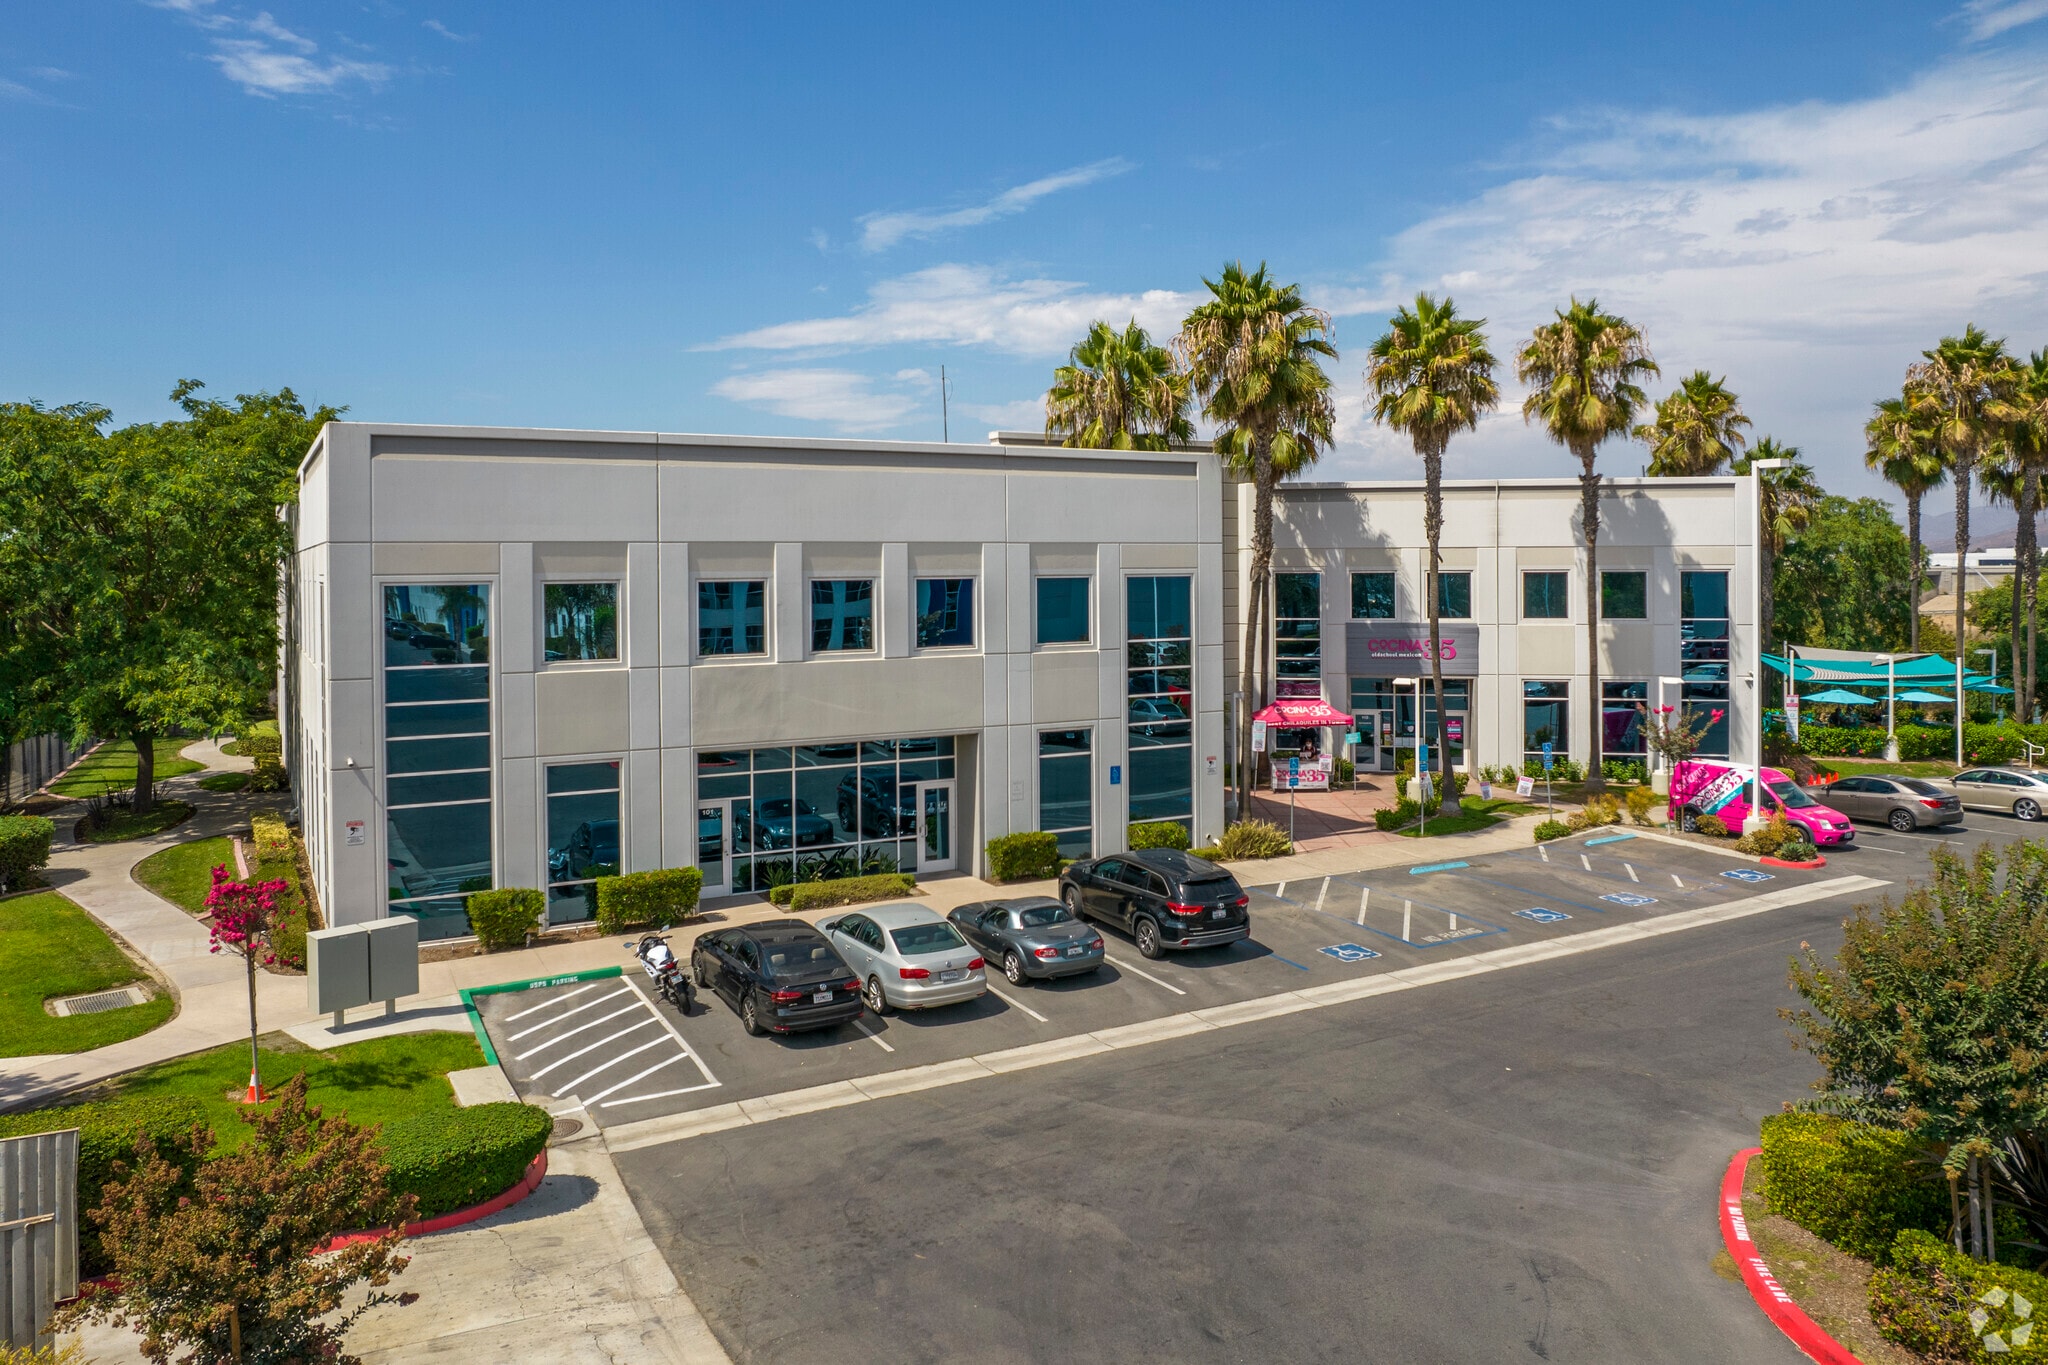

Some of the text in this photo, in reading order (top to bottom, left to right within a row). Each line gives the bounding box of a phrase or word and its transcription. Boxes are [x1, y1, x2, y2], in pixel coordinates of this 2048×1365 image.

[1368, 638, 1423, 652] COCINA
[1274, 705, 1331, 717] COCINA 35
[1748, 1258, 1793, 1303] FIRE LANE
